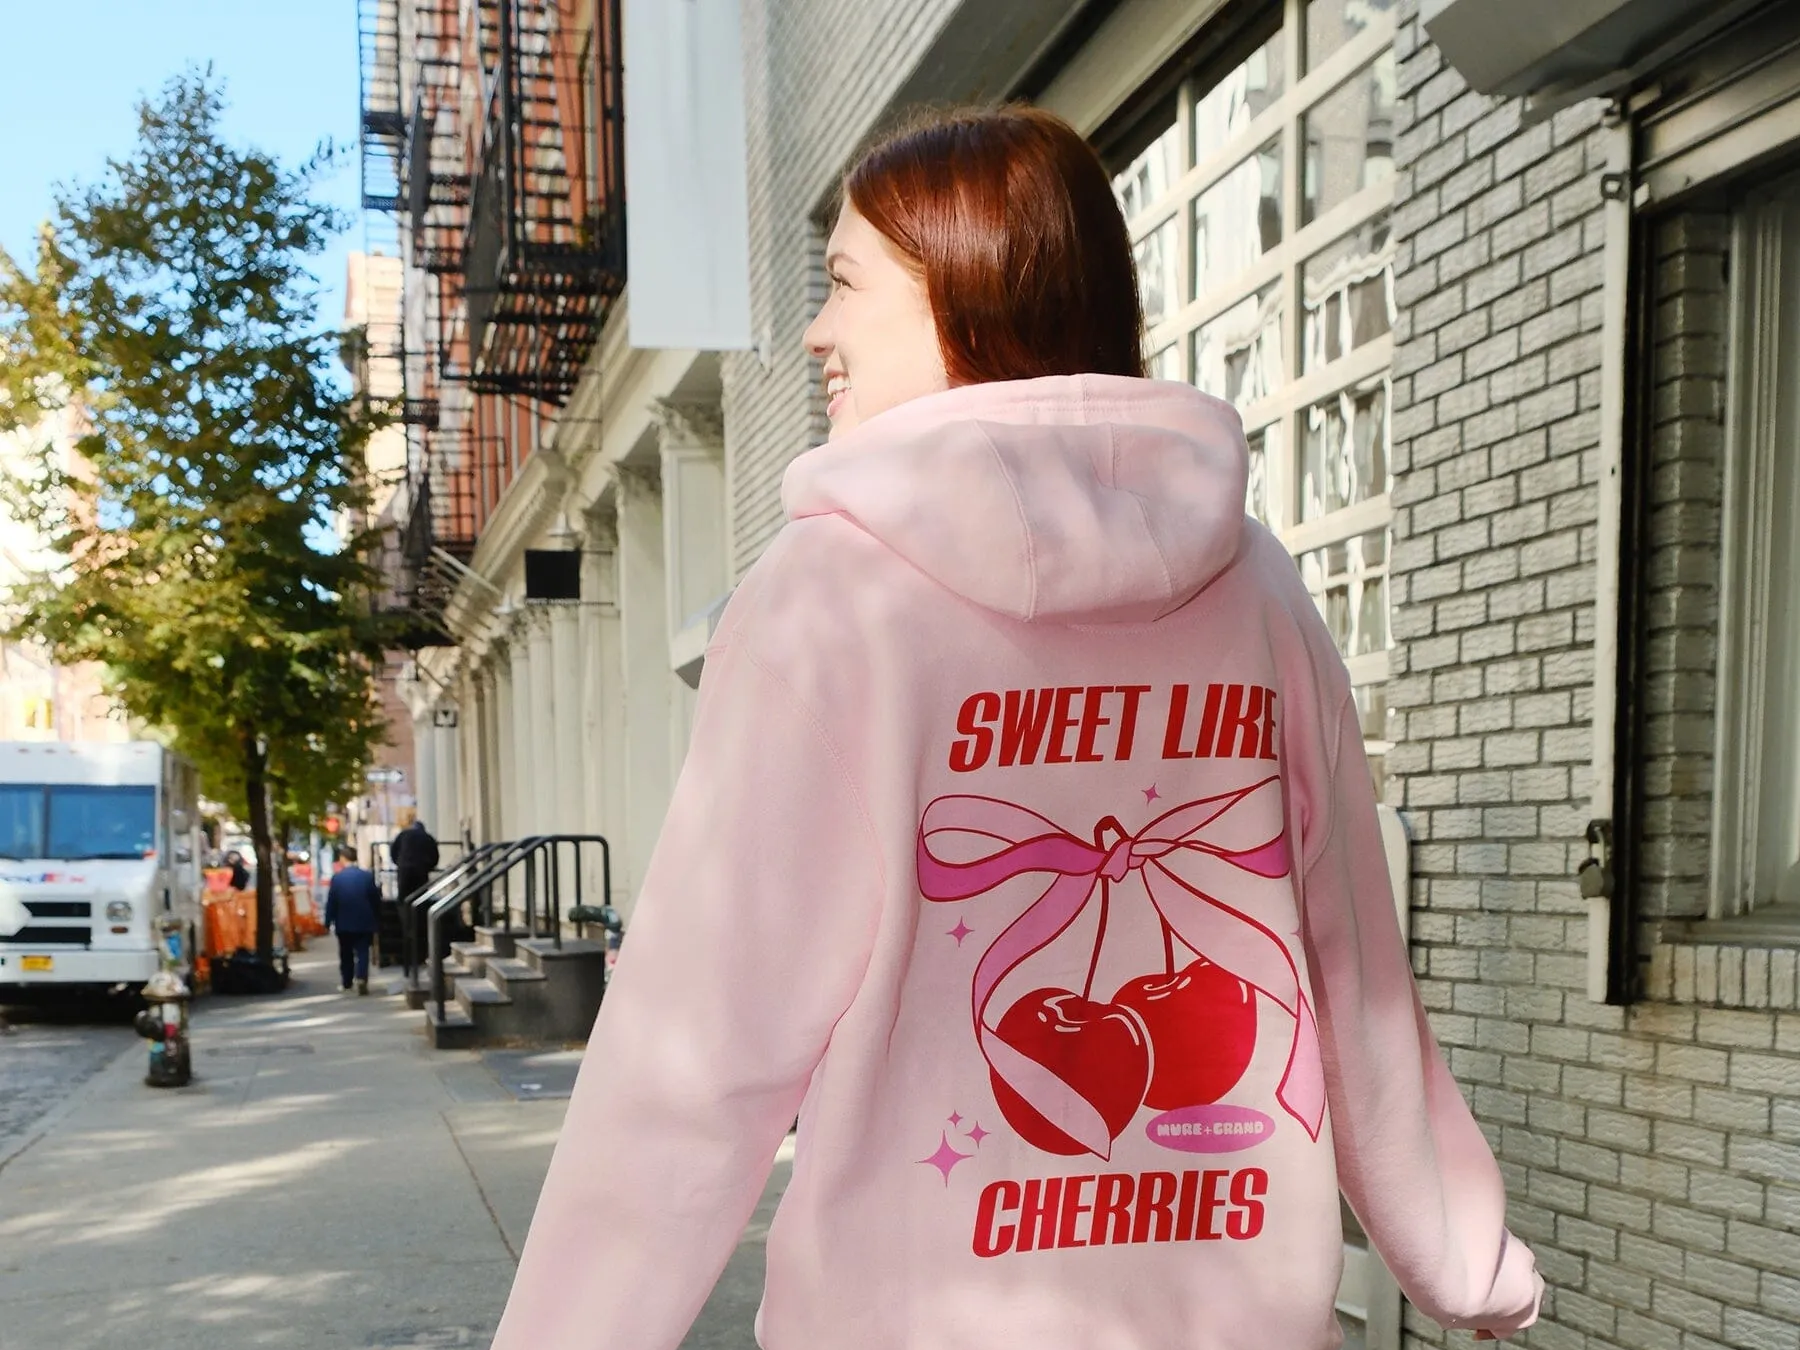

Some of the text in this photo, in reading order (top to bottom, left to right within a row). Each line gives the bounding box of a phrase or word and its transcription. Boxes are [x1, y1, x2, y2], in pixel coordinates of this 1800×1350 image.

[948, 683, 1279, 773] SWEET LIKE
[971, 1167, 1270, 1259] CHERRIES
